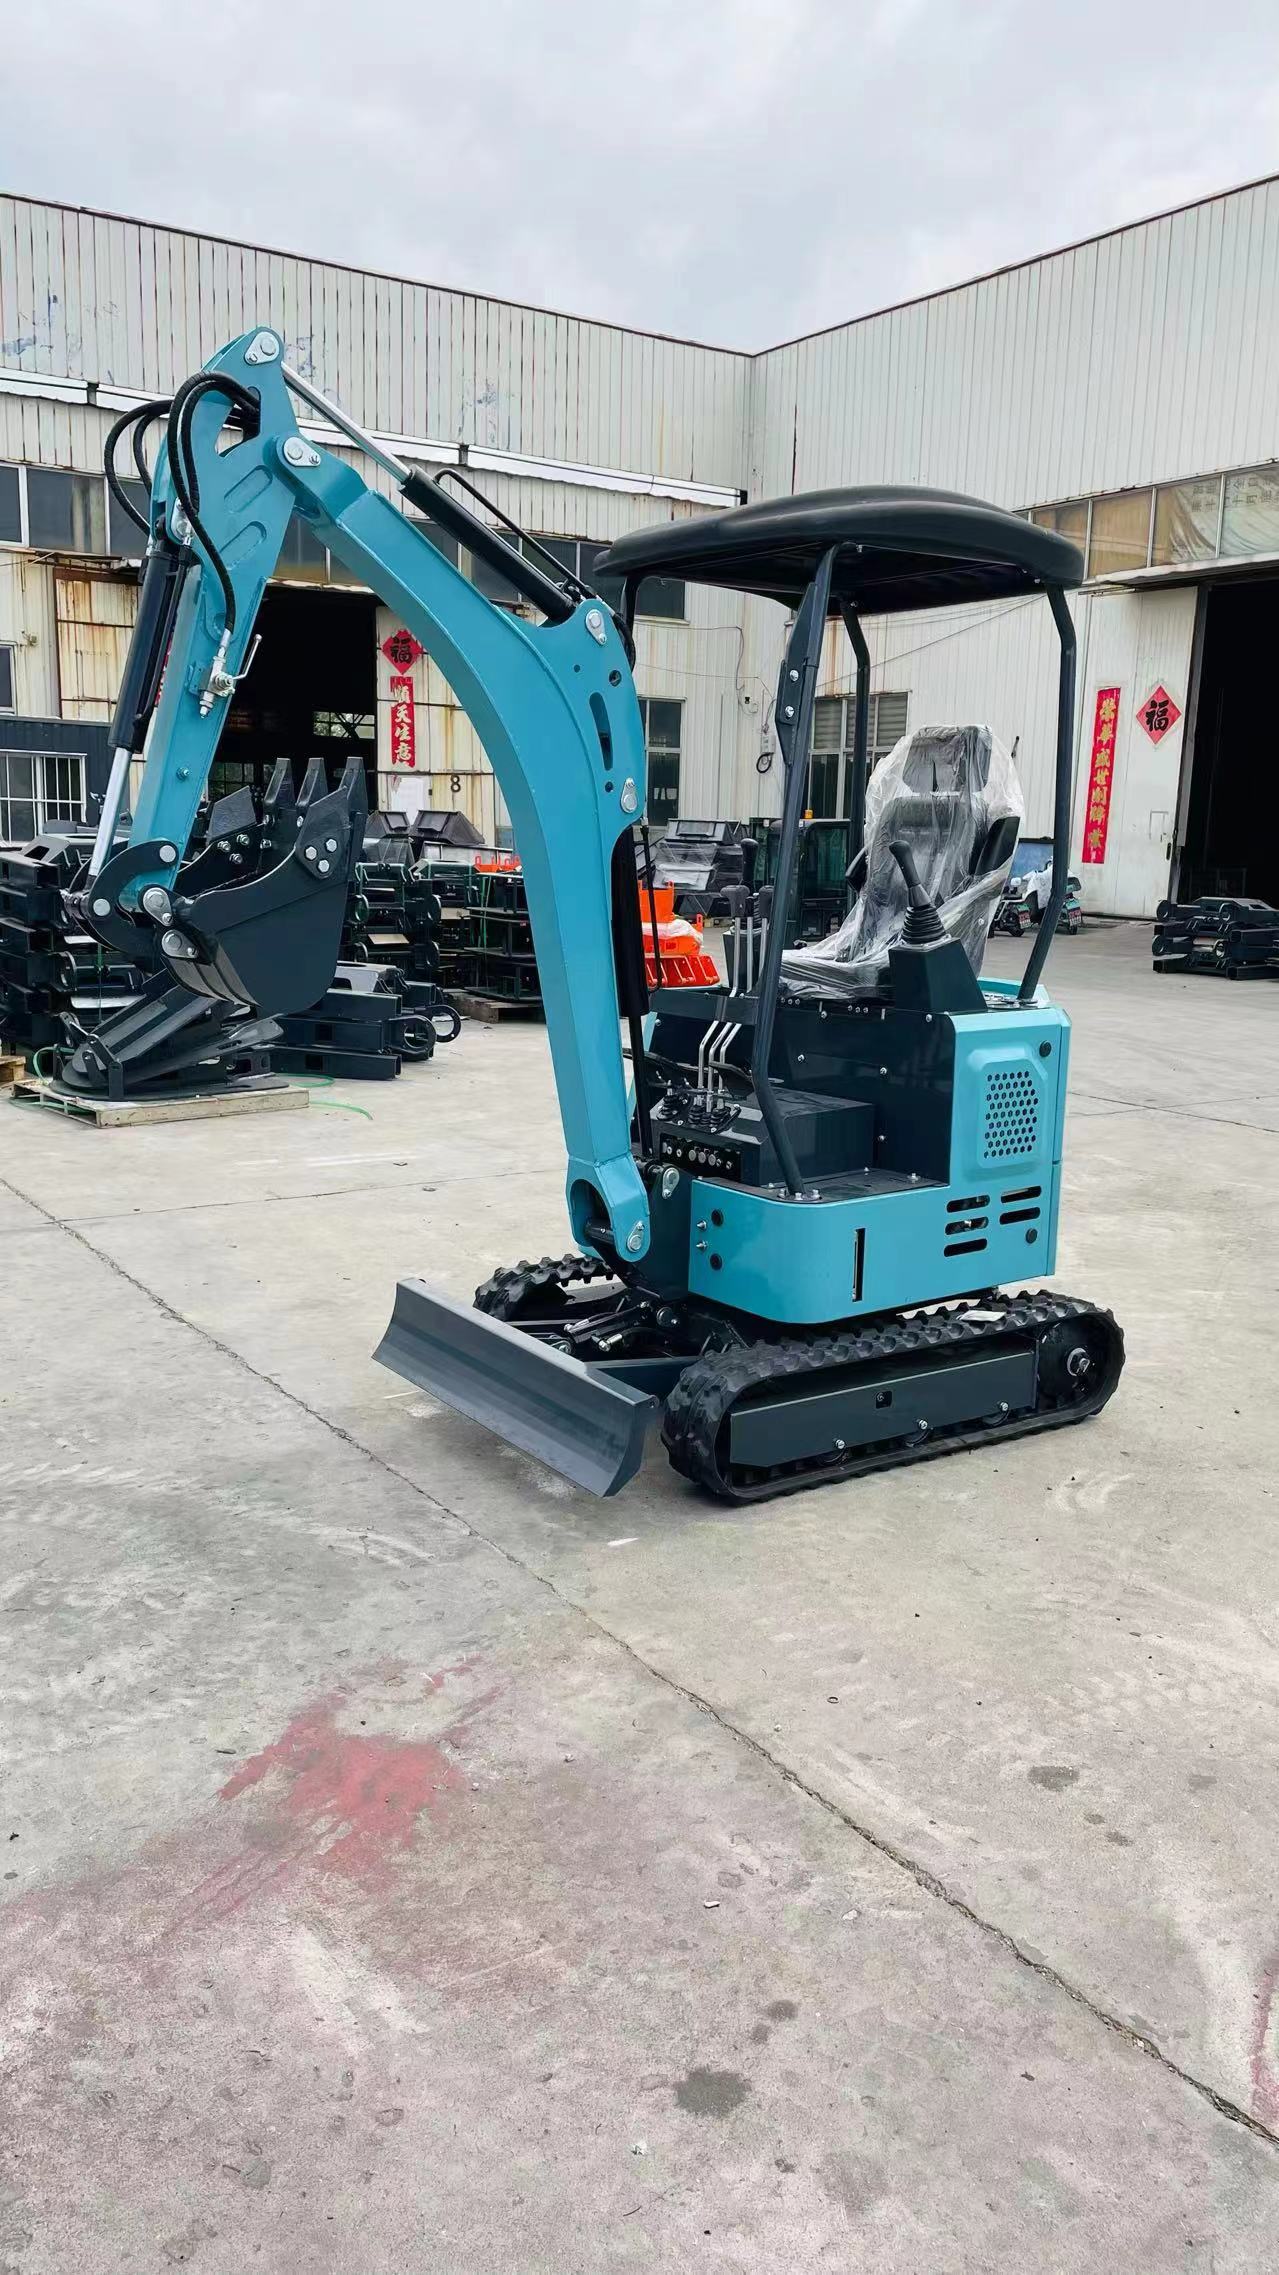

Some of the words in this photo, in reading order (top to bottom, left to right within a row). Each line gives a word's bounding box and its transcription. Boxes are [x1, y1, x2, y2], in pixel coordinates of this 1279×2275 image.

[390, 637, 413, 664] 福
[1145, 699, 1170, 731] 福
[450, 774, 461, 792] 8
